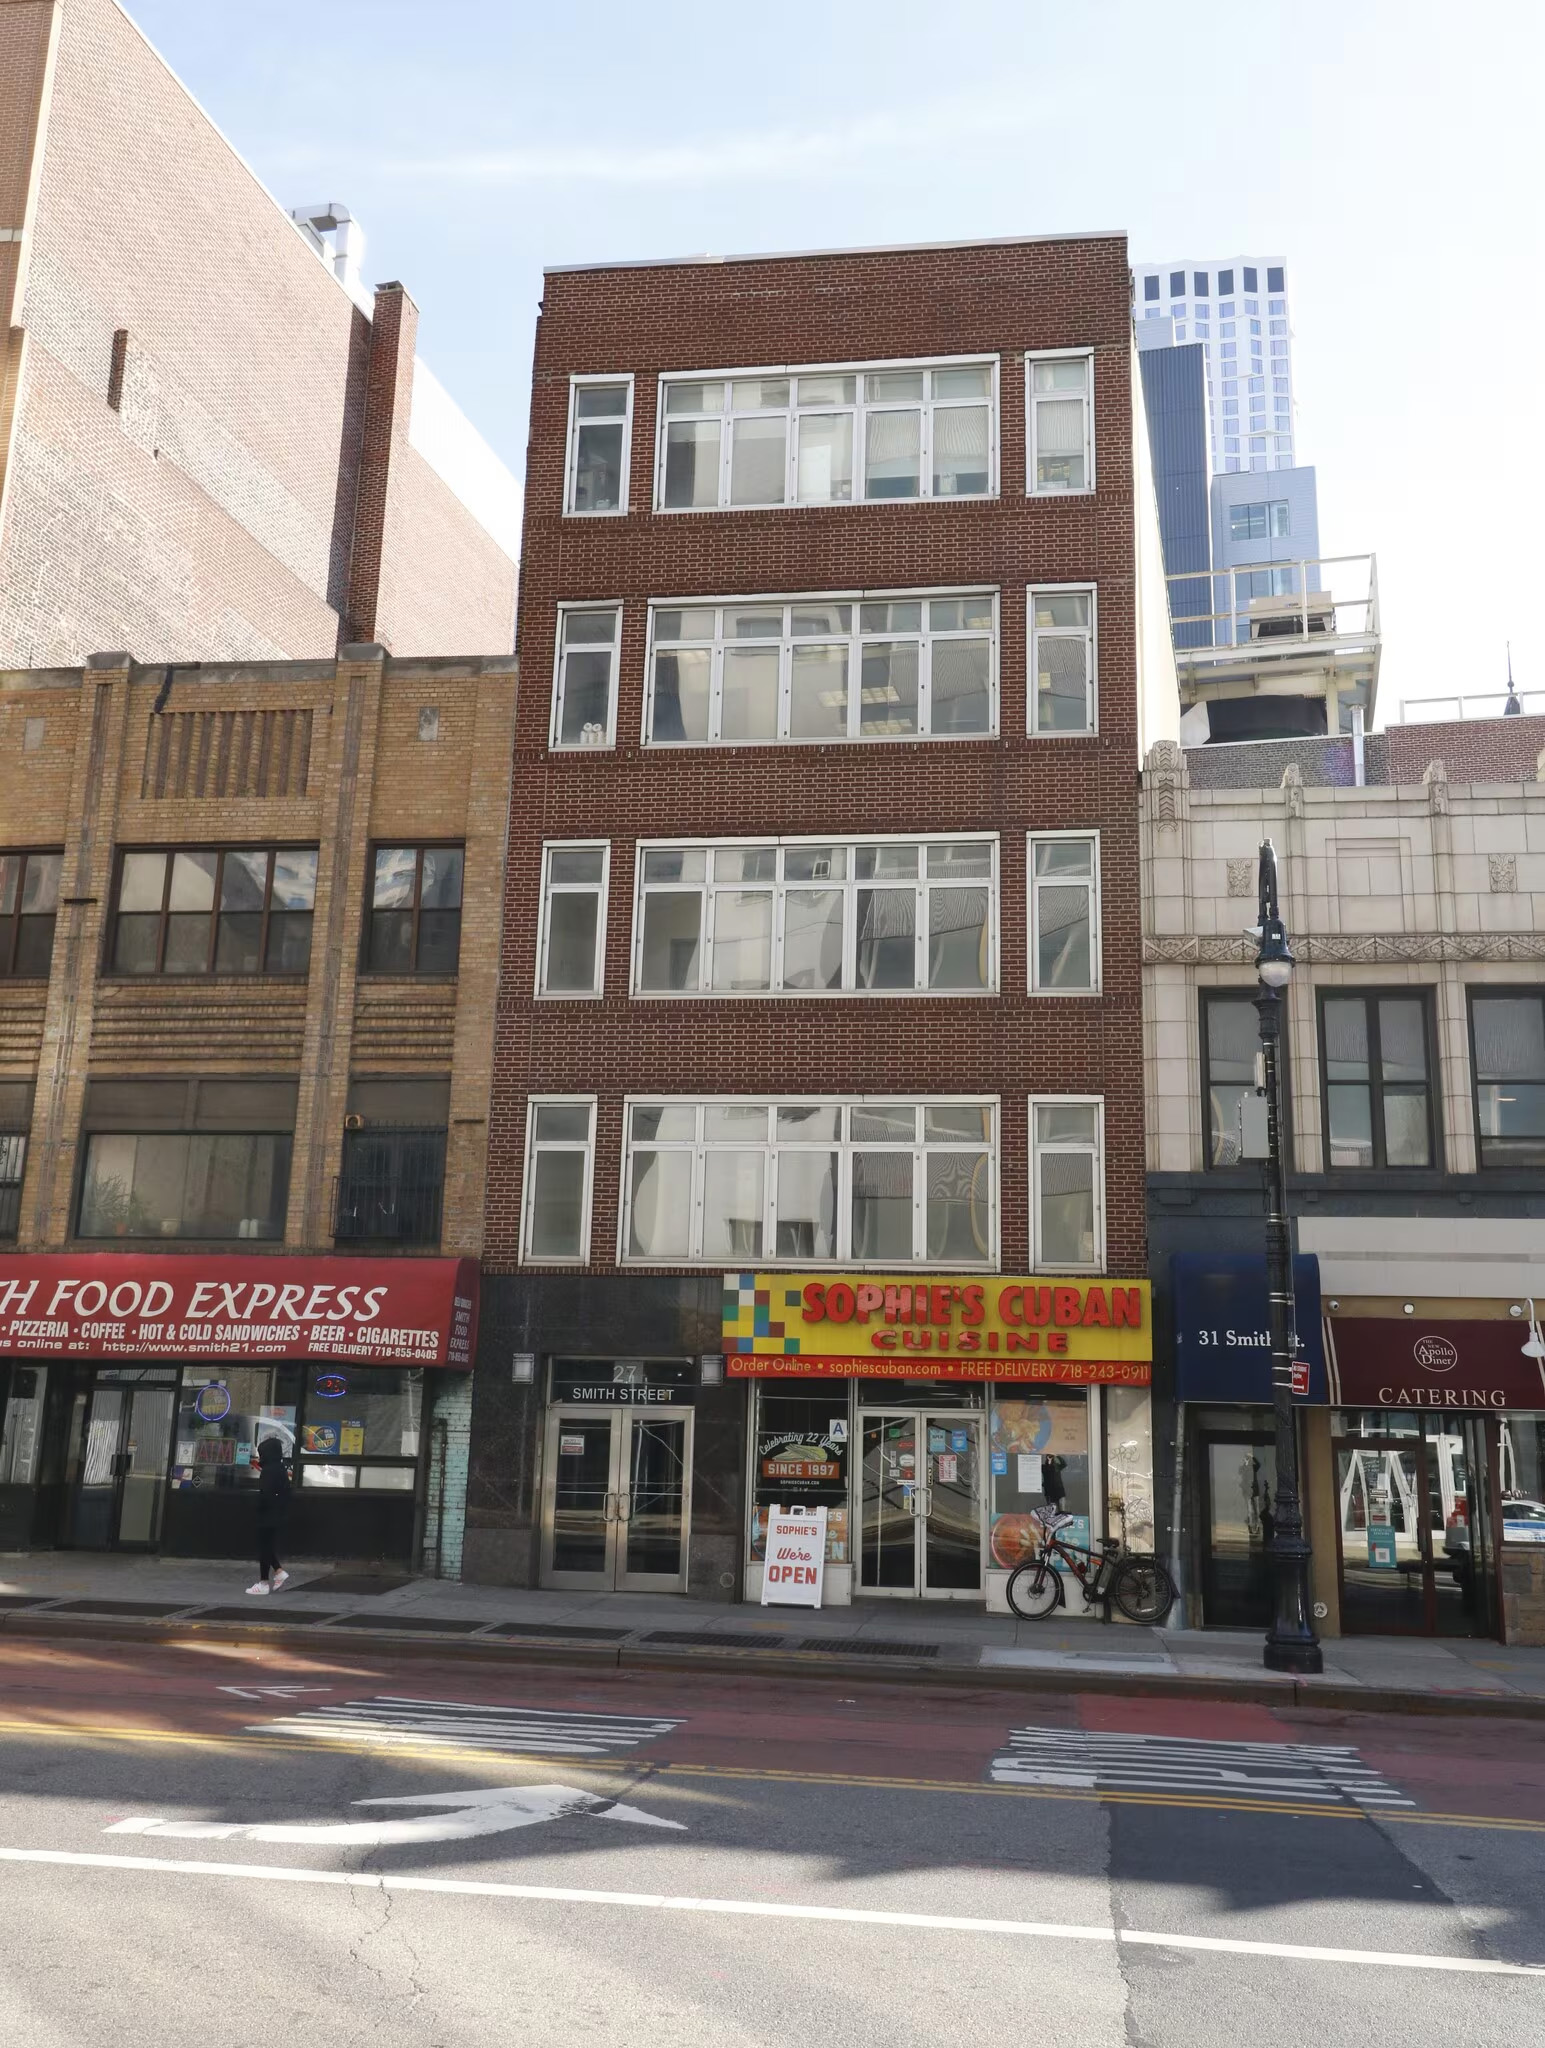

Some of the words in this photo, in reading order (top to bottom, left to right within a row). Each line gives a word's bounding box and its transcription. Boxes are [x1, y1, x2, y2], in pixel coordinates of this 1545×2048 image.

[46, 1281, 174, 1318] FOOD
[185, 1282, 388, 1321] EXPRESS
[802, 1283, 985, 1326] SOPHIE'S
[998, 1286, 1141, 1328] CUBAN
[9, 1320, 69, 1338] PIZZERIA
[81, 1322, 126, 1340] COFFEE
[138, 1324, 164, 1341] HOT
[166, 1324, 175, 1341] &
[179, 1324, 213, 1341] COLD
[214, 1324, 300, 1342] SANDWICHES
[310, 1325, 345, 1342] BEER
[356, 1326, 440, 1348] CIGARETTES
[871, 1330, 1068, 1353] CUISINE
[1198, 1330, 1219, 1346] 31
[0, 1340, 12, 1348] s
[17, 1338, 63, 1349] online
[68, 1342, 90, 1350] at:
[102, 1341, 287, 1353] http://www.smith21.com
[308, 1342, 330, 1353] FREE
[331, 1345, 374, 1356] DELIVERY
[375, 1346, 438, 1360] 718-855-0405
[1418, 1345, 1454, 1358] Apollo
[731, 1357, 770, 1372] Order
[773, 1358, 812, 1373] Online
[829, 1359, 941, 1377] sophiescuban.com
[961, 1361, 991, 1376] FREE
[995, 1362, 1057, 1378] DELIVERY
[1060, 1364, 1149, 1380] 718-243-0911
[1421, 1354, 1452, 1365] Diner
[612, 1365, 637, 1383] 27
[572, 1387, 616, 1400] SMITH
[619, 1388, 675, 1401] STREET
[1378, 1387, 1507, 1407] CATERING
[832, 1422, 844, 1436] A
[759, 1432, 804, 1456] Celebrating
[806, 1432, 820, 1443] 22
[818, 1435, 844, 1456] Years
[768, 1463, 803, 1476] SINCE
[808, 1465, 835, 1477] 1997
[776, 1525, 818, 1537] SOPHIE'S
[777, 1546, 813, 1561] We're
[768, 1565, 818, 1585] OPEN
